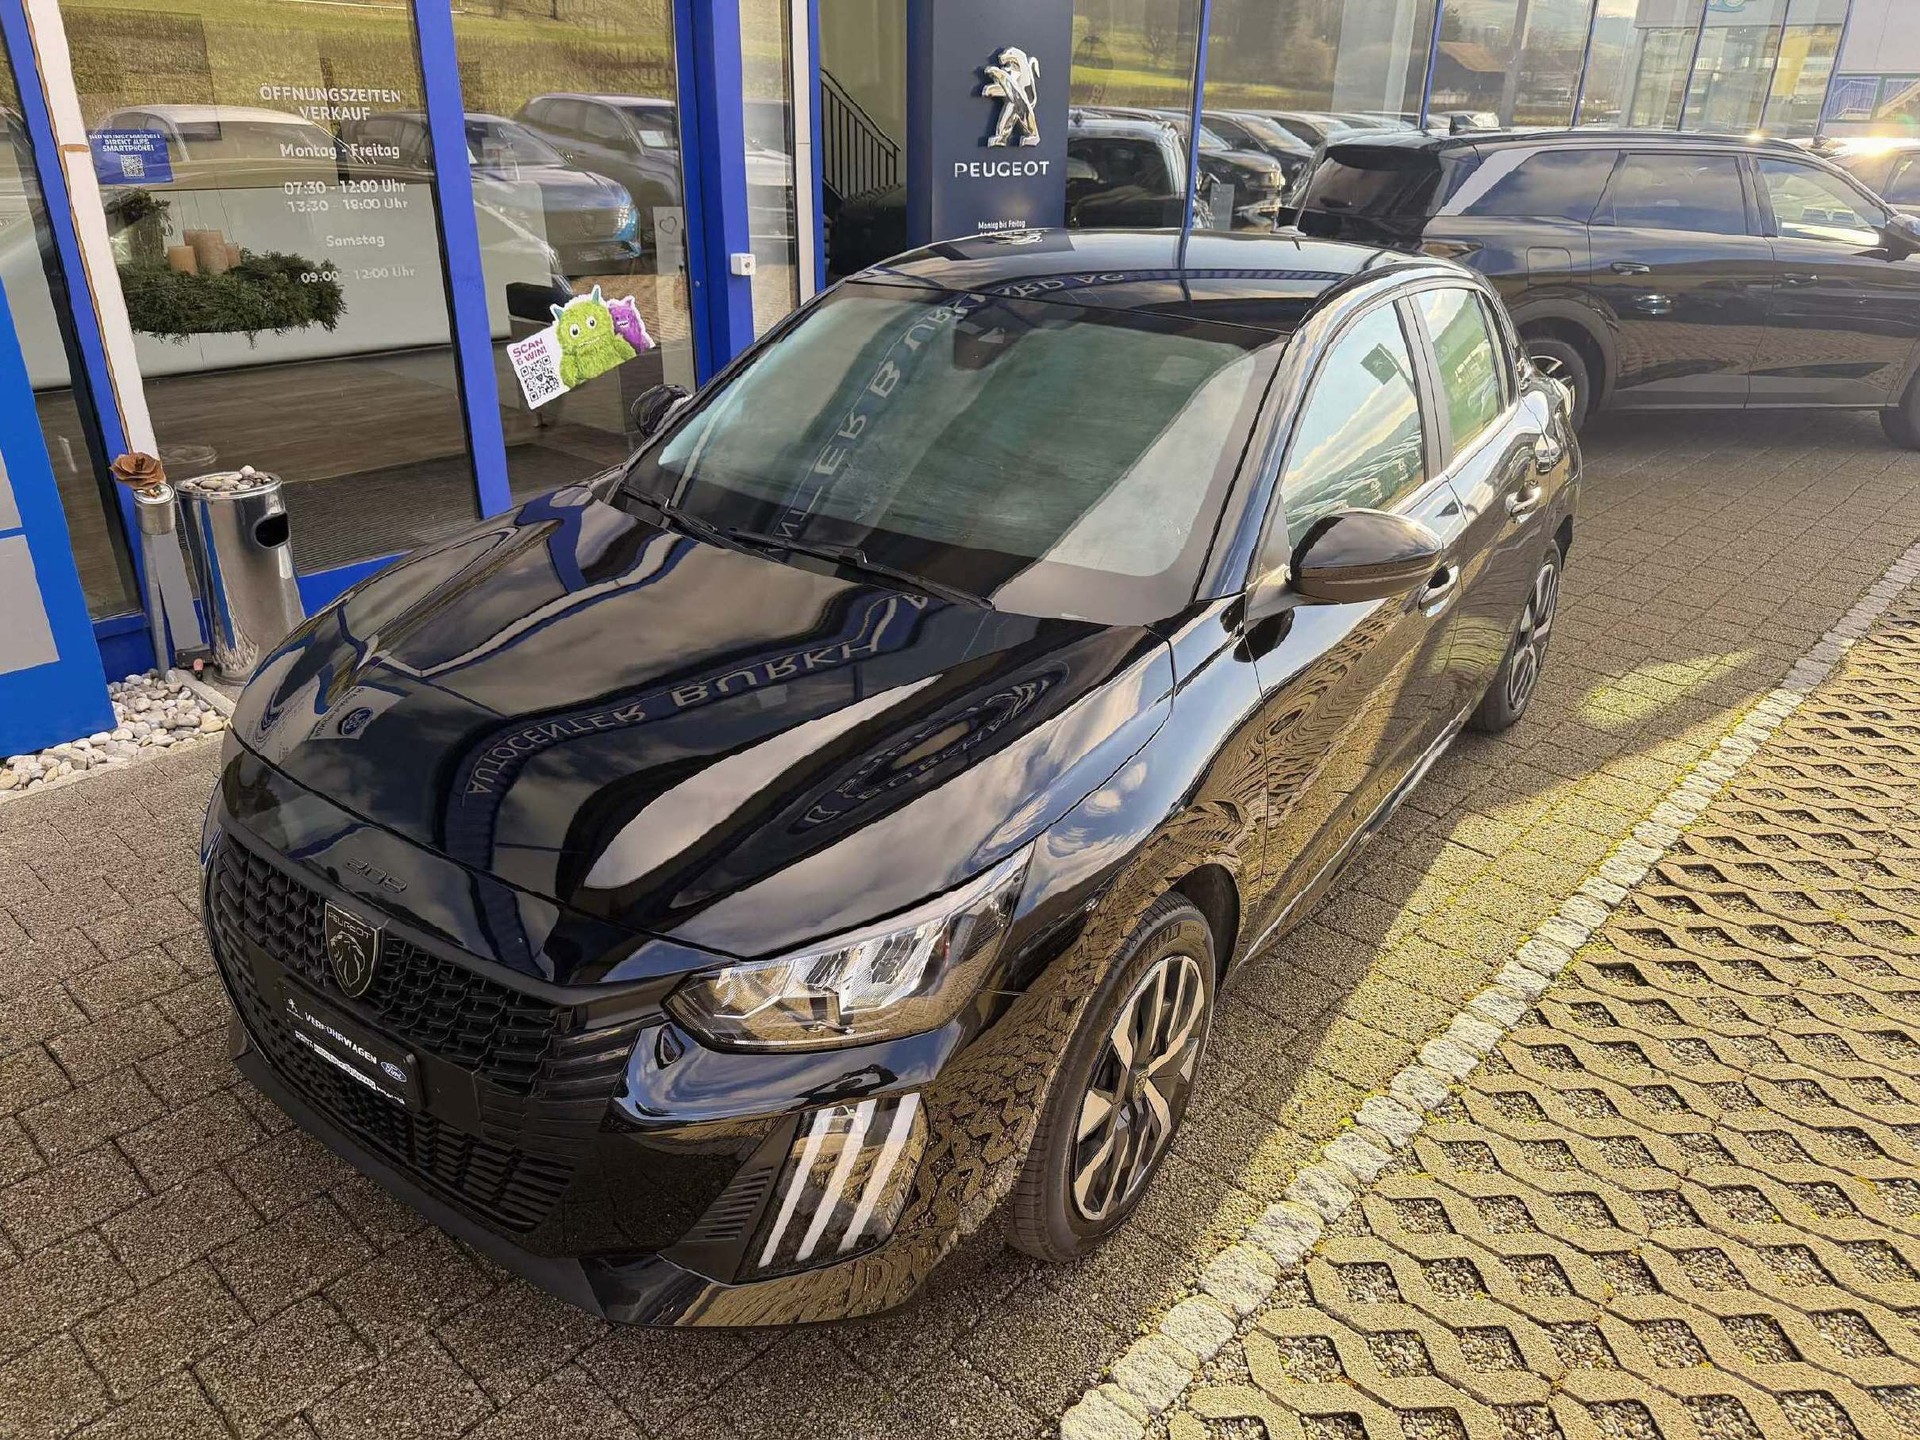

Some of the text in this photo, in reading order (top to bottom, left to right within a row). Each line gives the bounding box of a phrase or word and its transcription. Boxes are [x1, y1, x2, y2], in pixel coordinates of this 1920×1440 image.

[260, 83, 401, 102] ÖFFNUNGSZEITEN
[299, 106, 371, 120] VERKAUF
[280, 143, 337, 162] Montag
[350, 143, 400, 162] Freitag
[954, 160, 1050, 178] PEUGEOT
[284, 181, 326, 195] 07:30
[340, 179, 378, 193] 12:00
[382, 178, 406, 192] Uhr
[287, 199, 329, 213] 13:30
[343, 198, 381, 210] 18:00
[384, 198, 408, 209] Uhr
[326, 235, 385, 247] Samstag
[300, 270, 339, 283] 09:00
[393, 266, 415, 277] Uhr
[512, 337, 544, 358] SCAN
